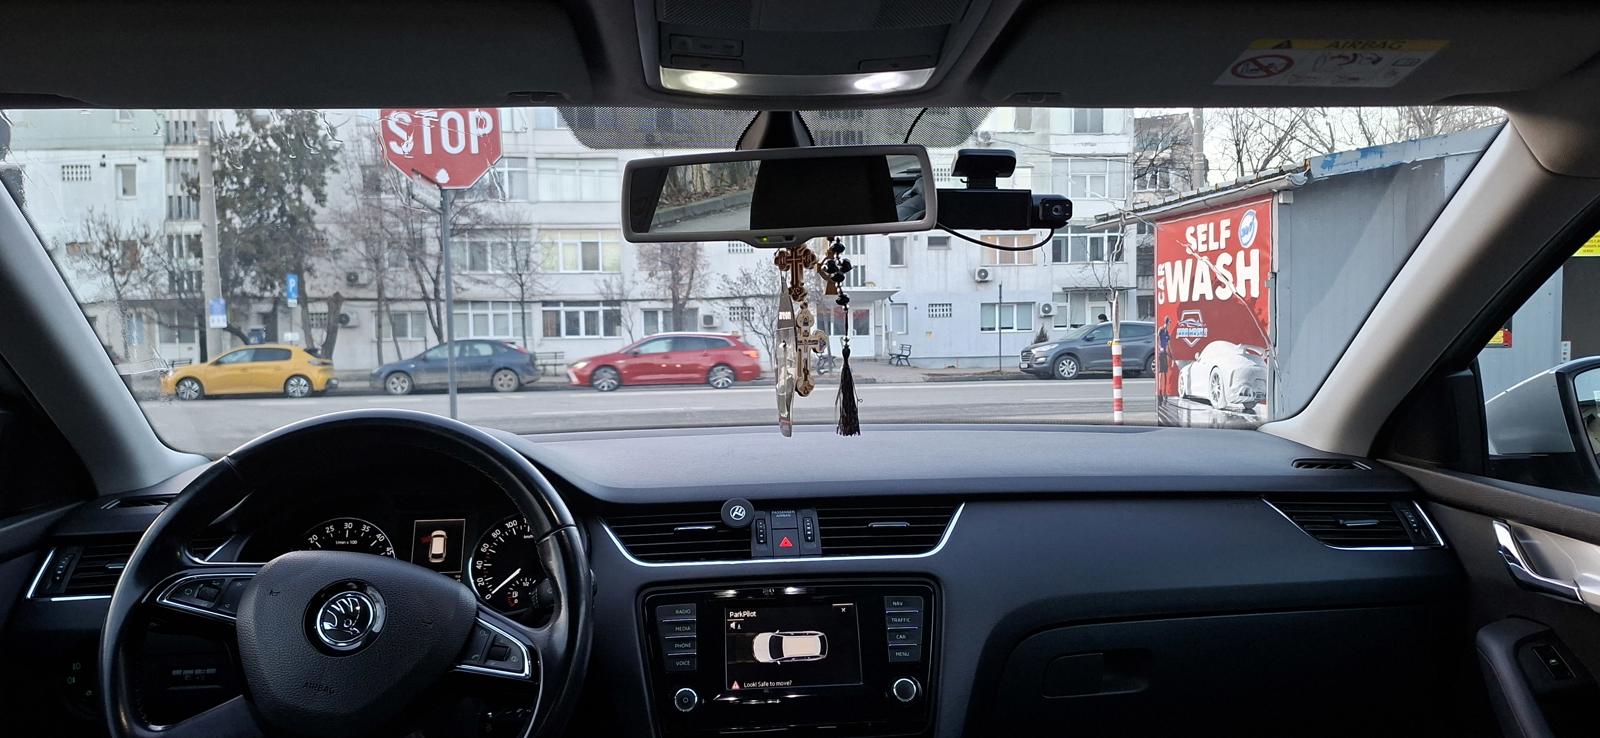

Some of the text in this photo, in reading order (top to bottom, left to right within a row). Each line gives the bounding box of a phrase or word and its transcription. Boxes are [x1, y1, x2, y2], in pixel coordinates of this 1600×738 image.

[1326, 40, 1406, 49] AIRBAG
[387, 110, 494, 155] STOP
[1186, 218, 1231, 254] SELF
[1164, 248, 1260, 303] WASH
[289, 278, 295, 292] P
[1157, 263, 1165, 305] CAR
[325, 525, 335, 534] 25
[361, 524, 371, 532] 35
[504, 520, 518, 529] 100
[375, 533, 385, 542] 40
[491, 529, 501, 538] 80
[308, 534, 318, 544] 20
[480, 543, 489, 553] 60
[476, 560, 483, 570] 40
[476, 577, 484, 587] 20
[729, 610, 757, 619] ParkPilot
[303, 682, 336, 694] AIRBAG
